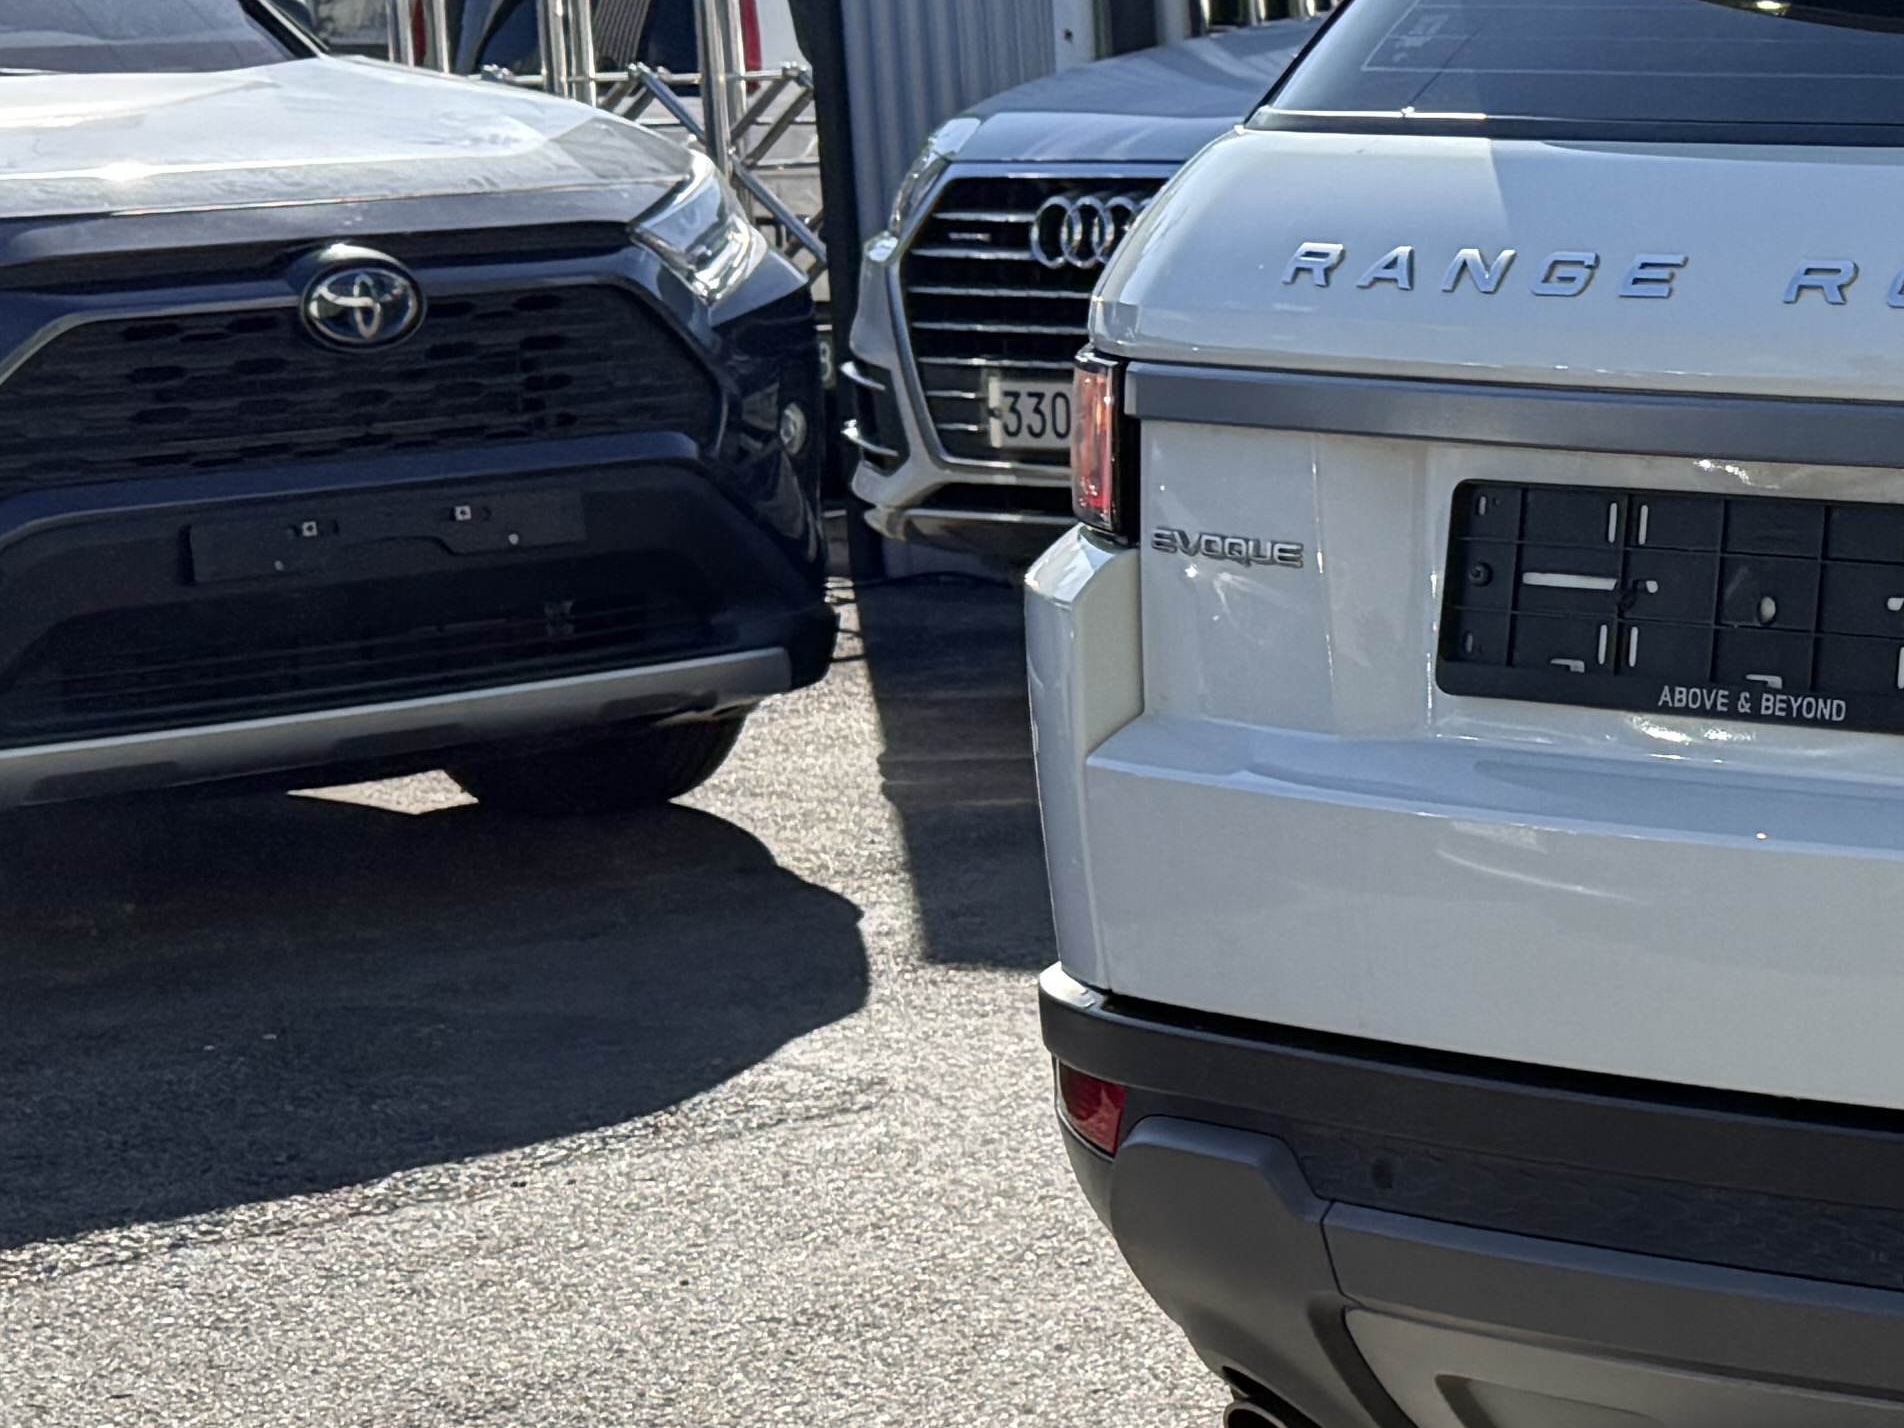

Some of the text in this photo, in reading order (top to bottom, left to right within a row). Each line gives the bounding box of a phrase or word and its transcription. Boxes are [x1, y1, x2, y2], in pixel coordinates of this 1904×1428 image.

[1282, 241, 1688, 299] RANGE
[1002, 390, 1071, 440] 330
[1151, 527, 1304, 569] EVOQUE
[1657, 684, 1847, 723] ABOVE & BEYOND
